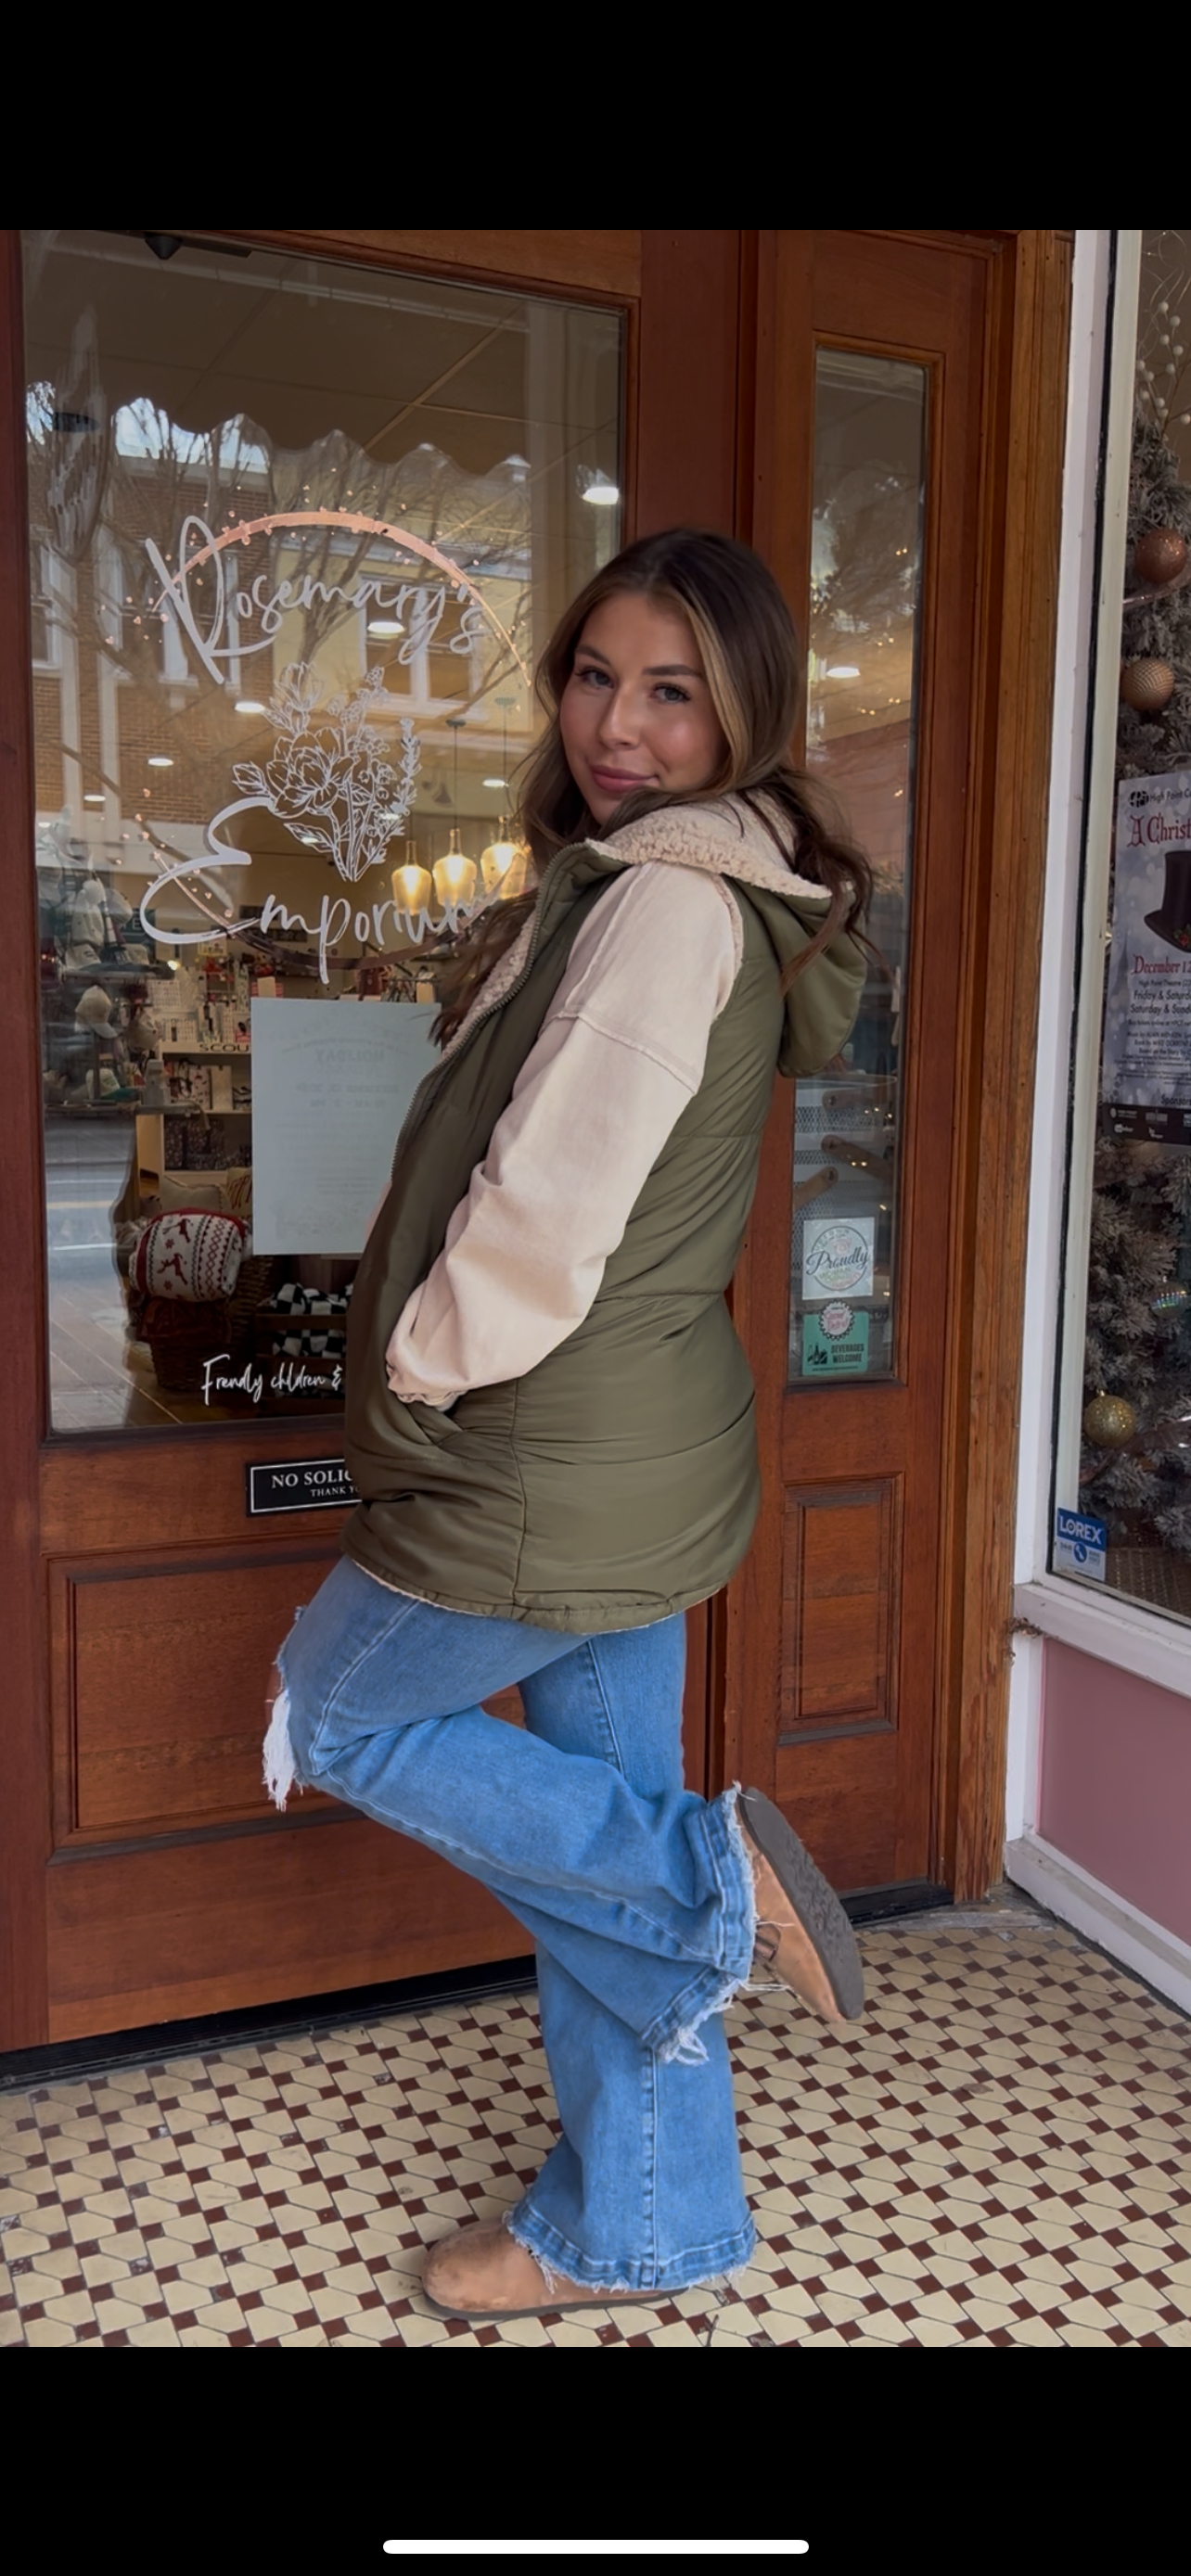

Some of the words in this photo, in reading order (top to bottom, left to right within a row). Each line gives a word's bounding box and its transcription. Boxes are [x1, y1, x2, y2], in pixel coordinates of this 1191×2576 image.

[145, 516, 485, 684] Rosemary's
[1127, 815, 1146, 848] A
[1131, 954, 1181, 976] December
[1133, 988, 1156, 1001] Friday
[1131, 1003, 1162, 1016] Saturday
[806, 1246, 869, 1275] Proudly
[831, 1343, 864, 1354] BEVERAGES
[833, 1353, 863, 1363] WELCOME
[331, 1363, 343, 1391] &
[271, 1473, 299, 1489] NO
[310, 1486, 346, 1498] THANK
[1059, 1515, 1103, 1545] LOREX
